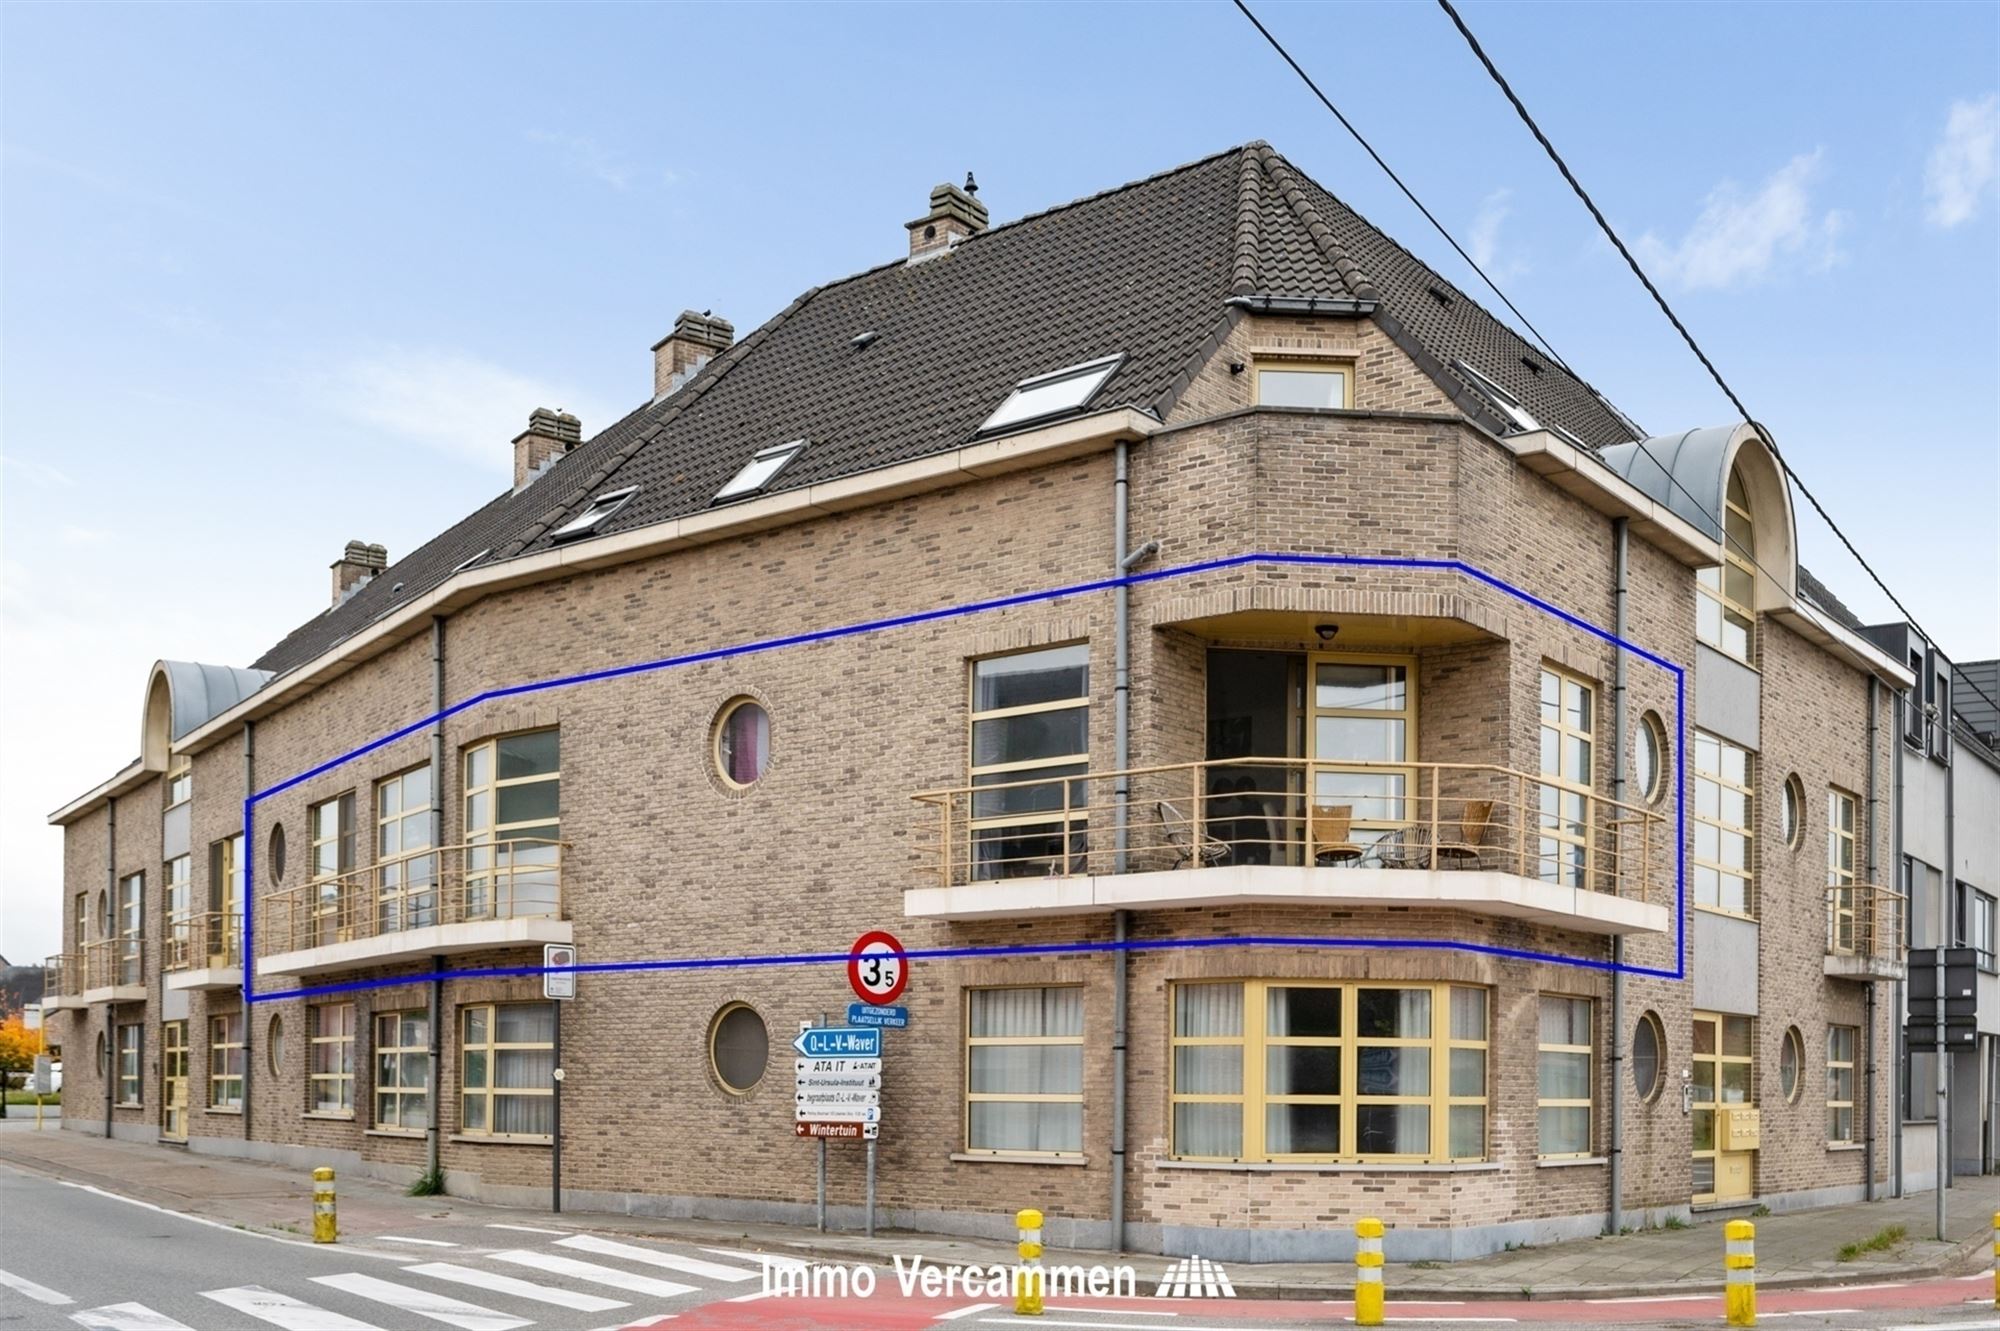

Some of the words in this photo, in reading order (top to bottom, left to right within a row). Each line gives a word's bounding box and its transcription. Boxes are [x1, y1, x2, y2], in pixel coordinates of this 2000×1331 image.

[851, 1014, 883, 1025] PLAATSELIJK
[884, 1017, 905, 1027] VERKEER
[813, 1061, 832, 1072] ATA
[835, 1061, 846, 1072] IT
[809, 1123, 857, 1137] Wintertuin
